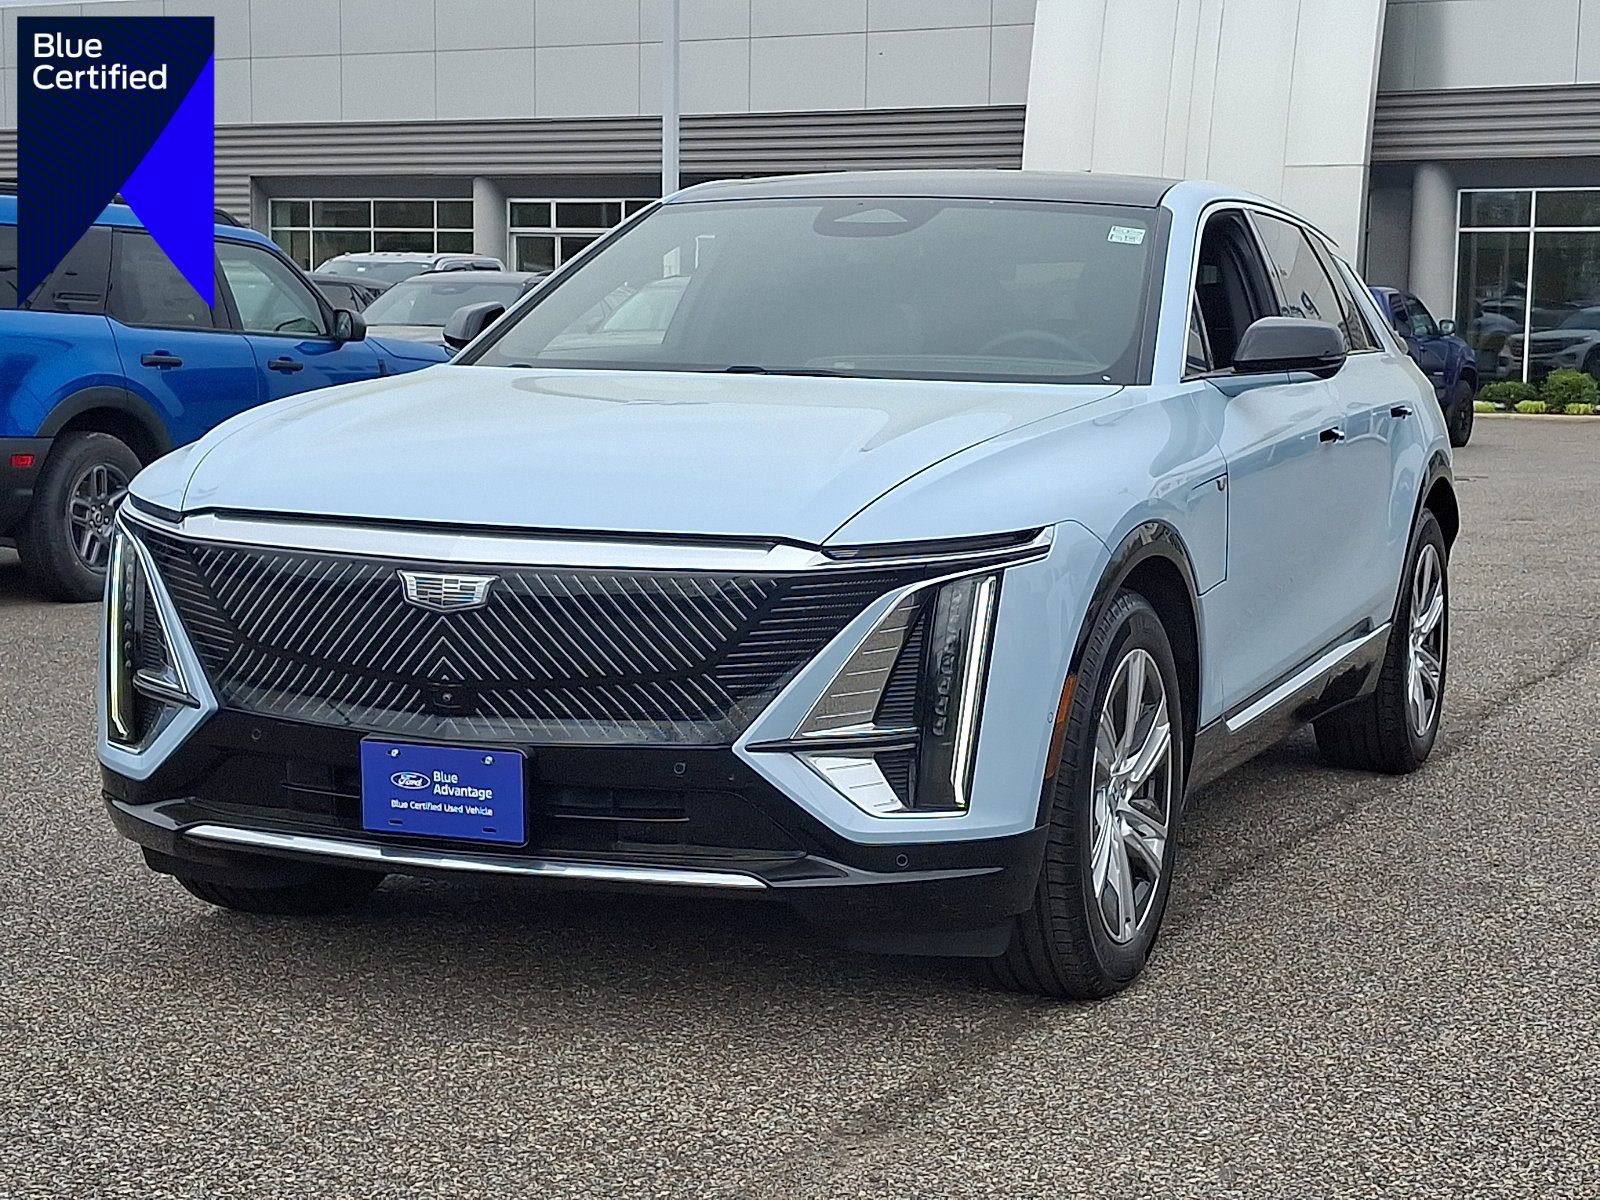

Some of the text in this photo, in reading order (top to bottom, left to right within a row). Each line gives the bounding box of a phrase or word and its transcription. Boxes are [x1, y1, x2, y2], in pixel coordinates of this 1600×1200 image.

[397, 773, 423, 787] Ford
[433, 770, 458, 784] Blue
[433, 783, 493, 800] Advantage
[391, 799, 493, 816] Blue Certified Used Vehicle
